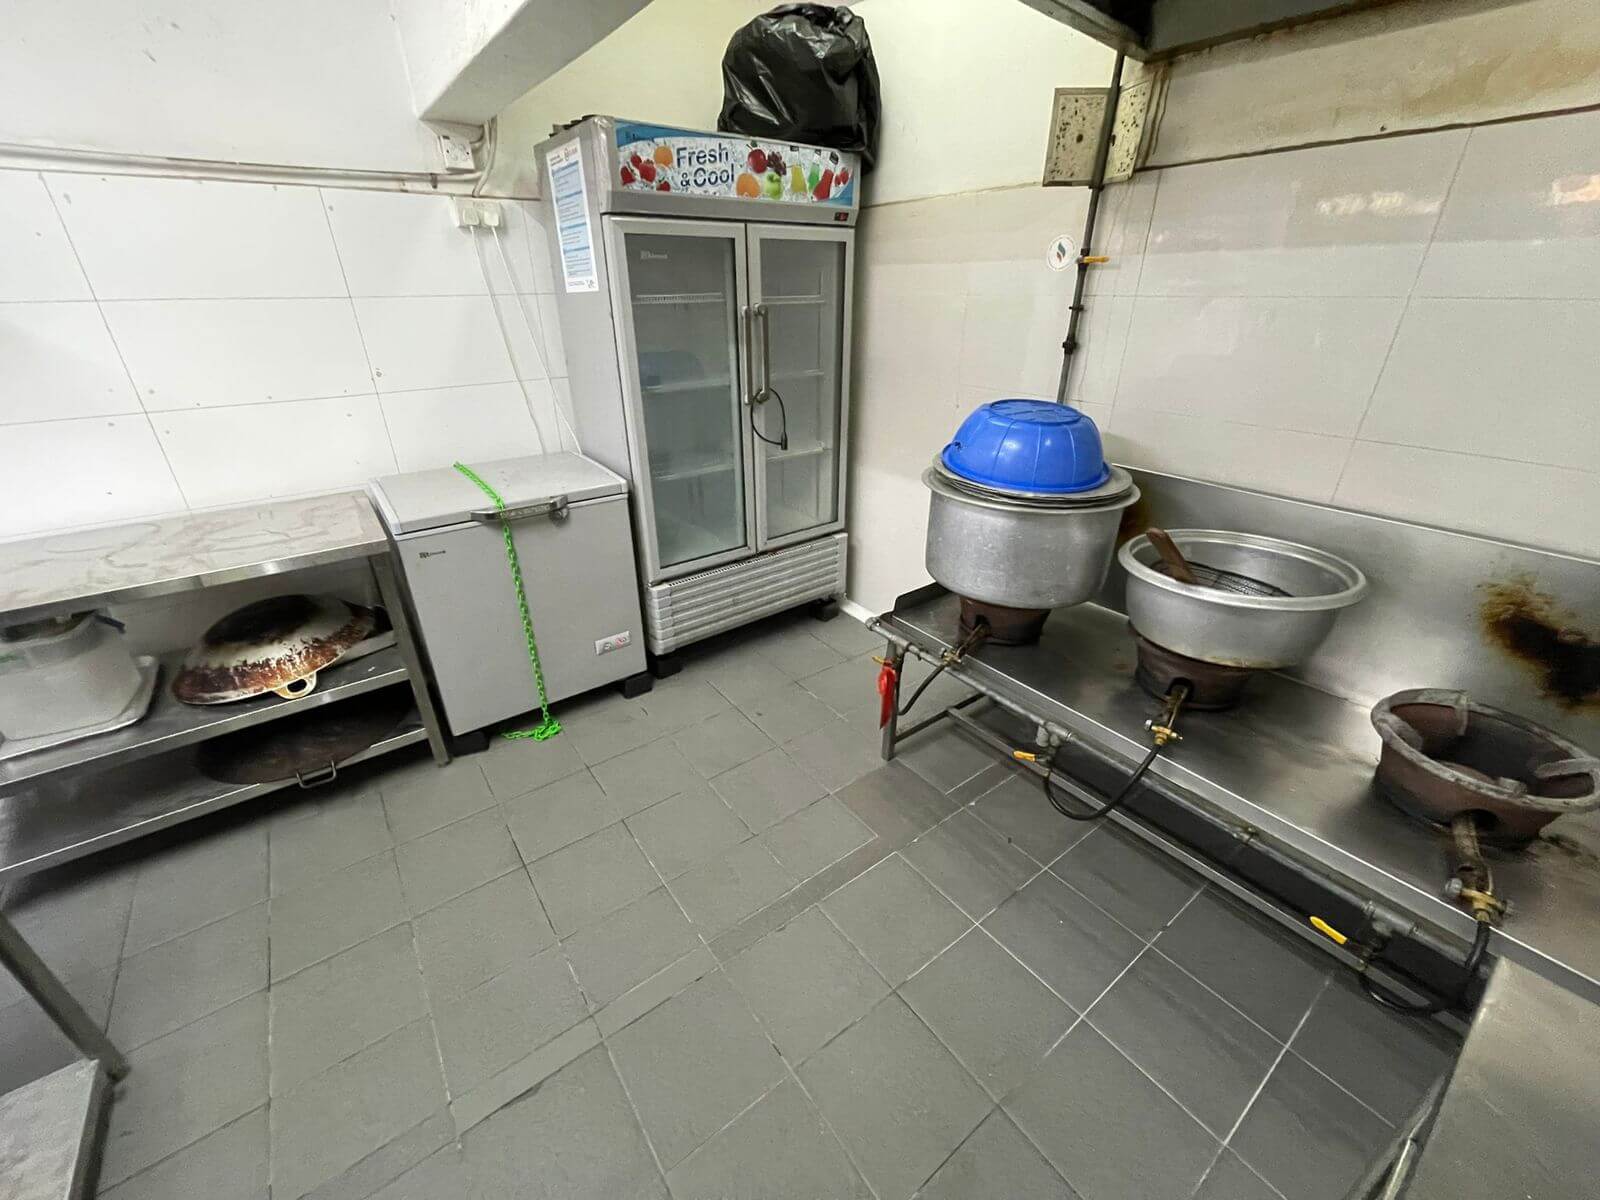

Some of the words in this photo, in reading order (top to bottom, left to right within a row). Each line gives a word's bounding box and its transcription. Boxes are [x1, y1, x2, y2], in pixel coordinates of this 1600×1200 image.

[676, 143, 729, 168] Fresh
[680, 172, 691, 187] &
[693, 163, 735, 187] Cool
